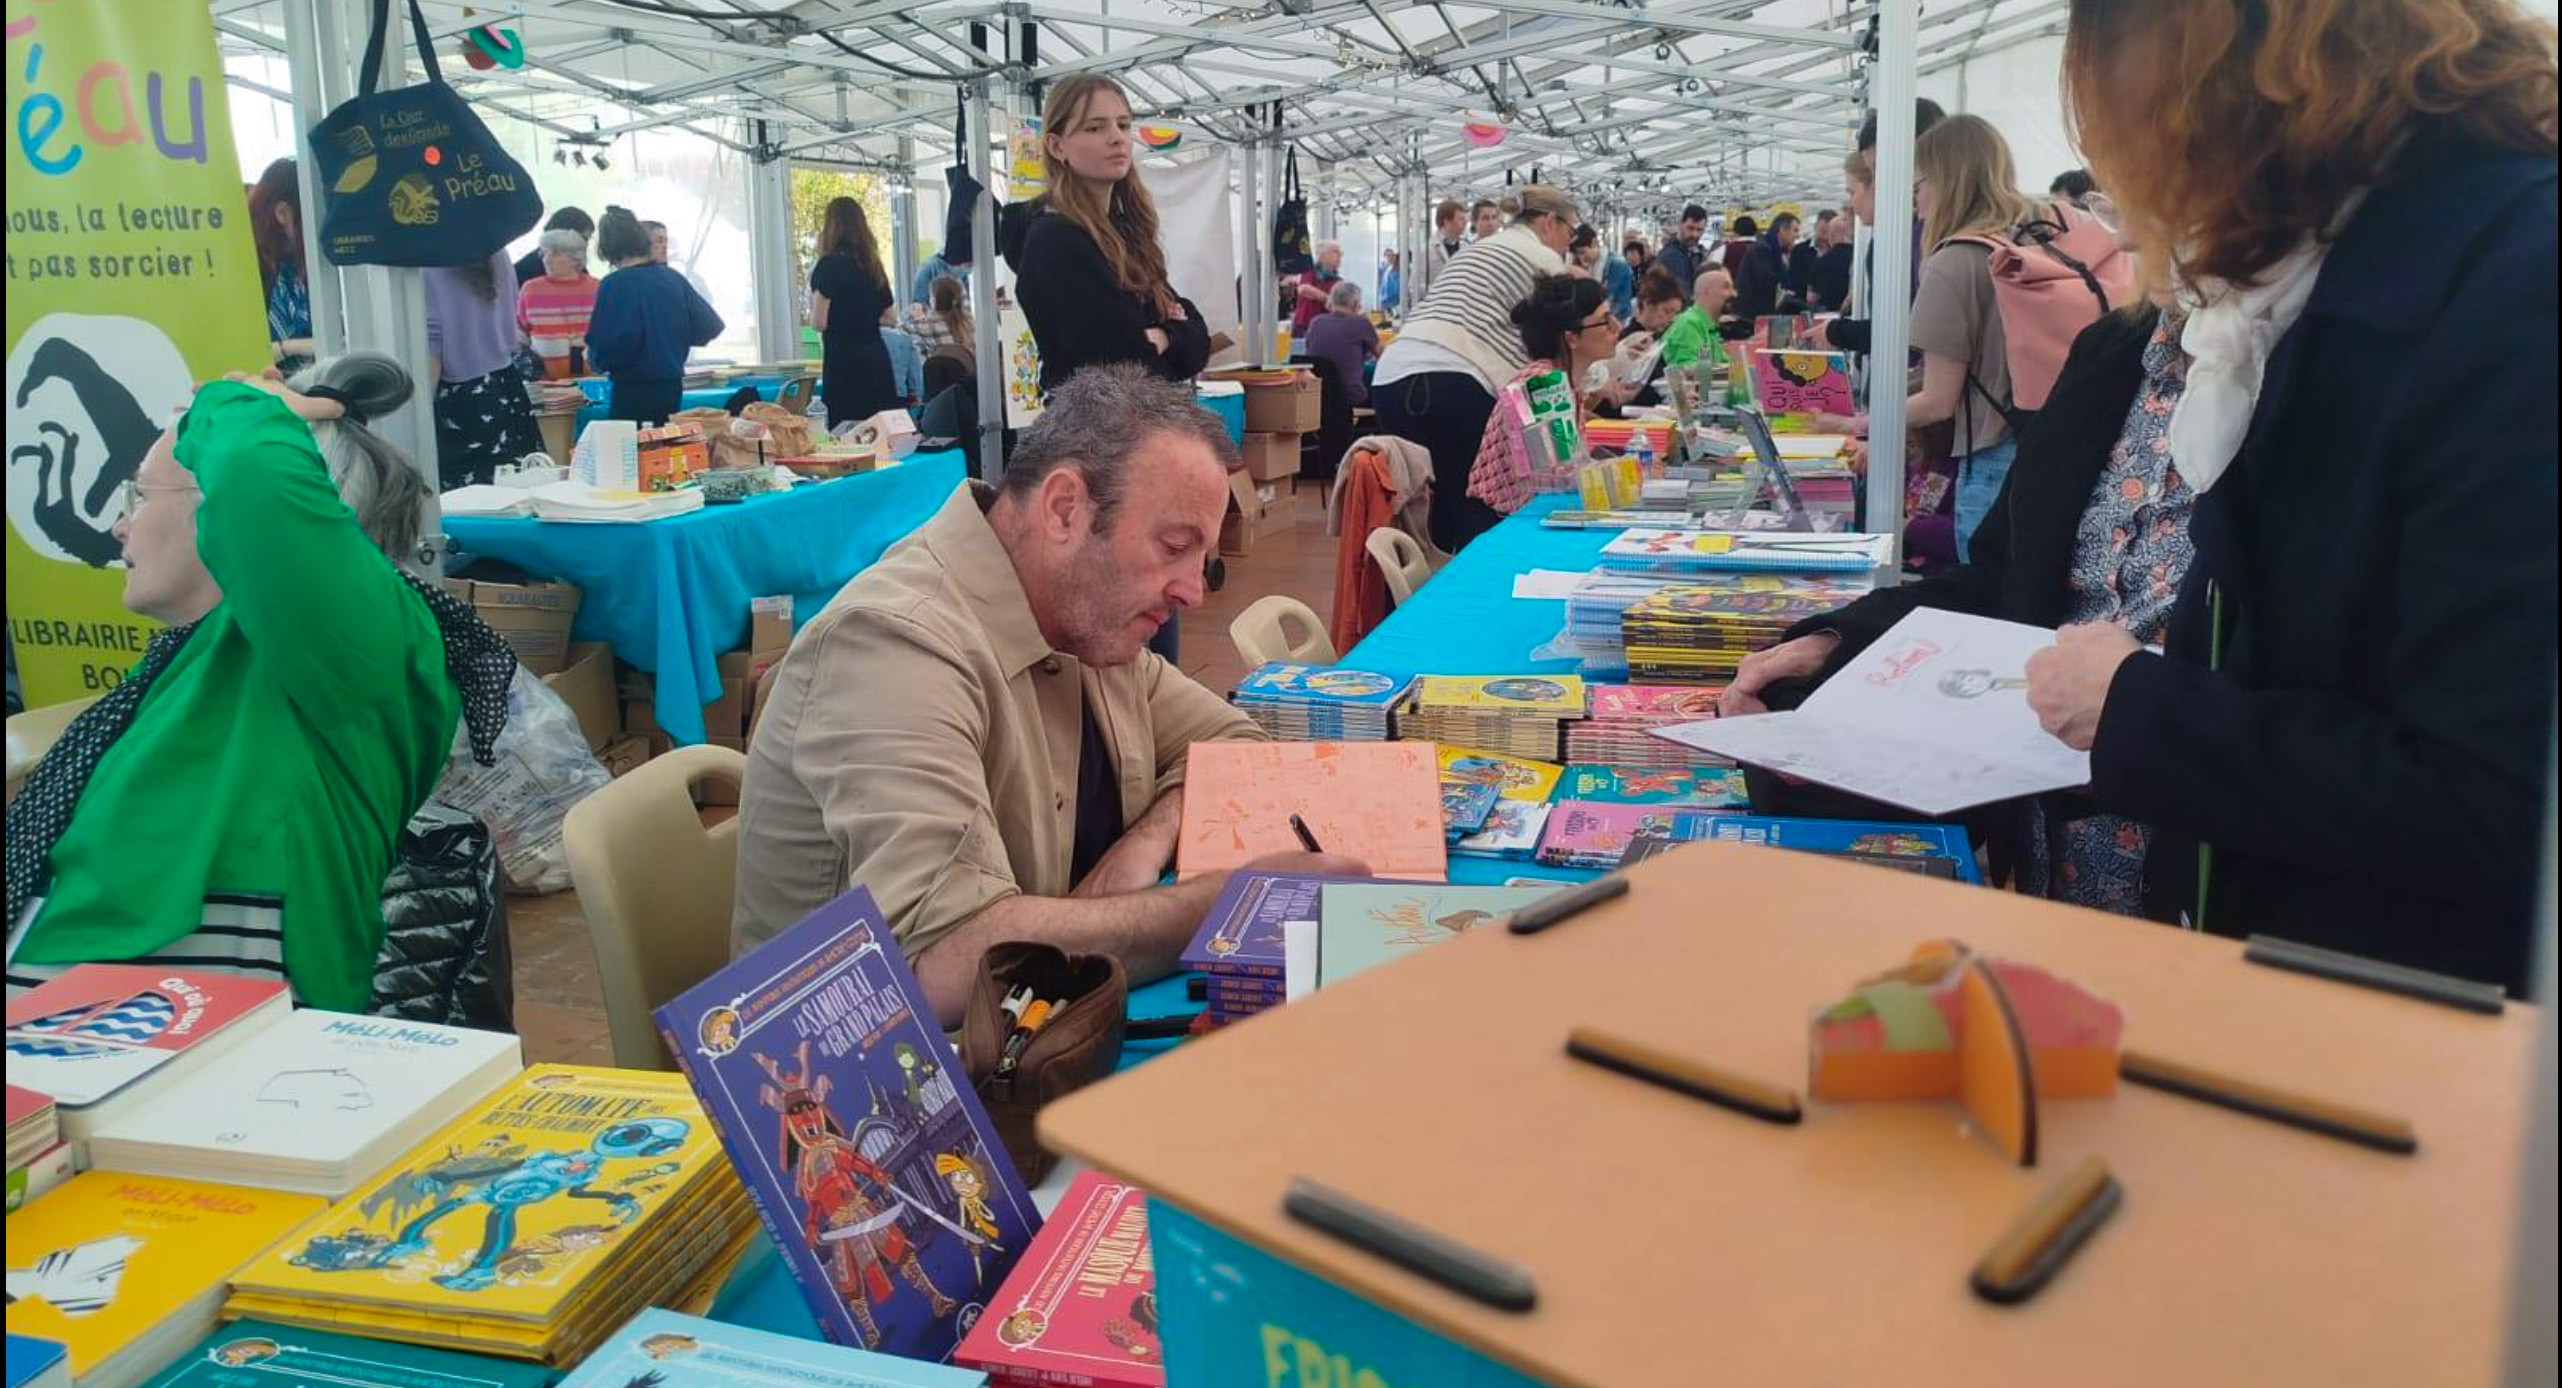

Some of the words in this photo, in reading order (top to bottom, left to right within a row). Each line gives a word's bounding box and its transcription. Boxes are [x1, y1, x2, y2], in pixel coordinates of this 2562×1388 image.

[456, 152, 484, 174] Le
[77, 203, 106, 233] la
[118, 202, 224, 232] lecture
[28, 255, 77, 281] pas
[88, 246, 194, 278] sorcier
[205, 248, 215, 278] !
[11, 618, 143, 653] LIBRAIRIE
[81, 662, 130, 692] BO
